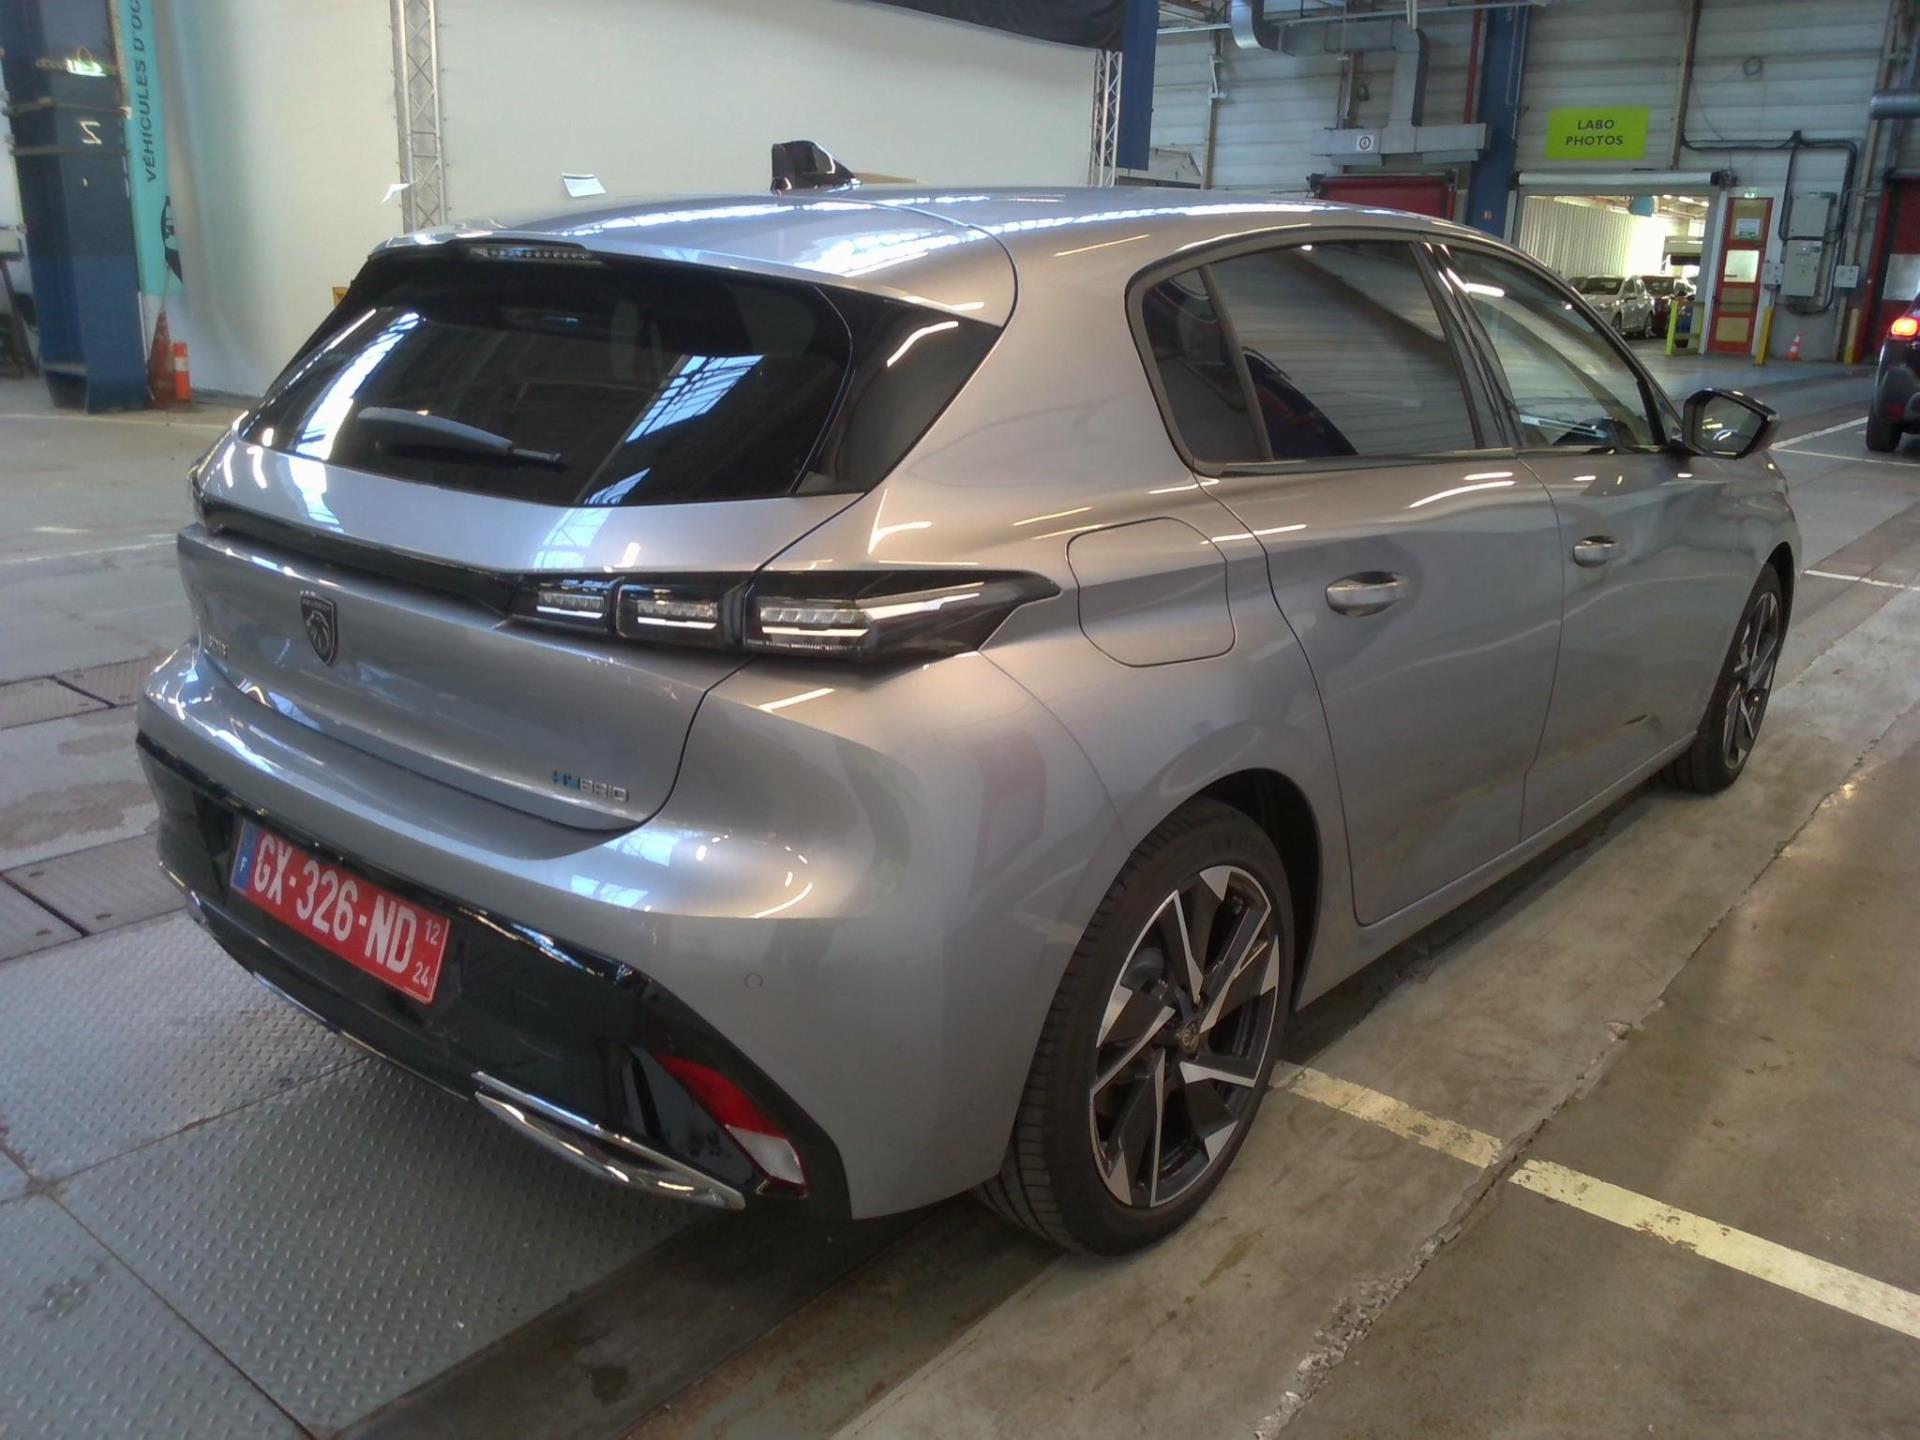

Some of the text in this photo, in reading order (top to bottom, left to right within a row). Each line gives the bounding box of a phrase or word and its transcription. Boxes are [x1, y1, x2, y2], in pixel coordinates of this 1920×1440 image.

[135, 60, 157, 183] VÉHICULES
[1577, 119, 1615, 130] LABO
[1565, 135, 1624, 146] PHOTOS
[239, 857, 248, 873] F
[425, 919, 441, 946] 12
[412, 961, 430, 988] 24
